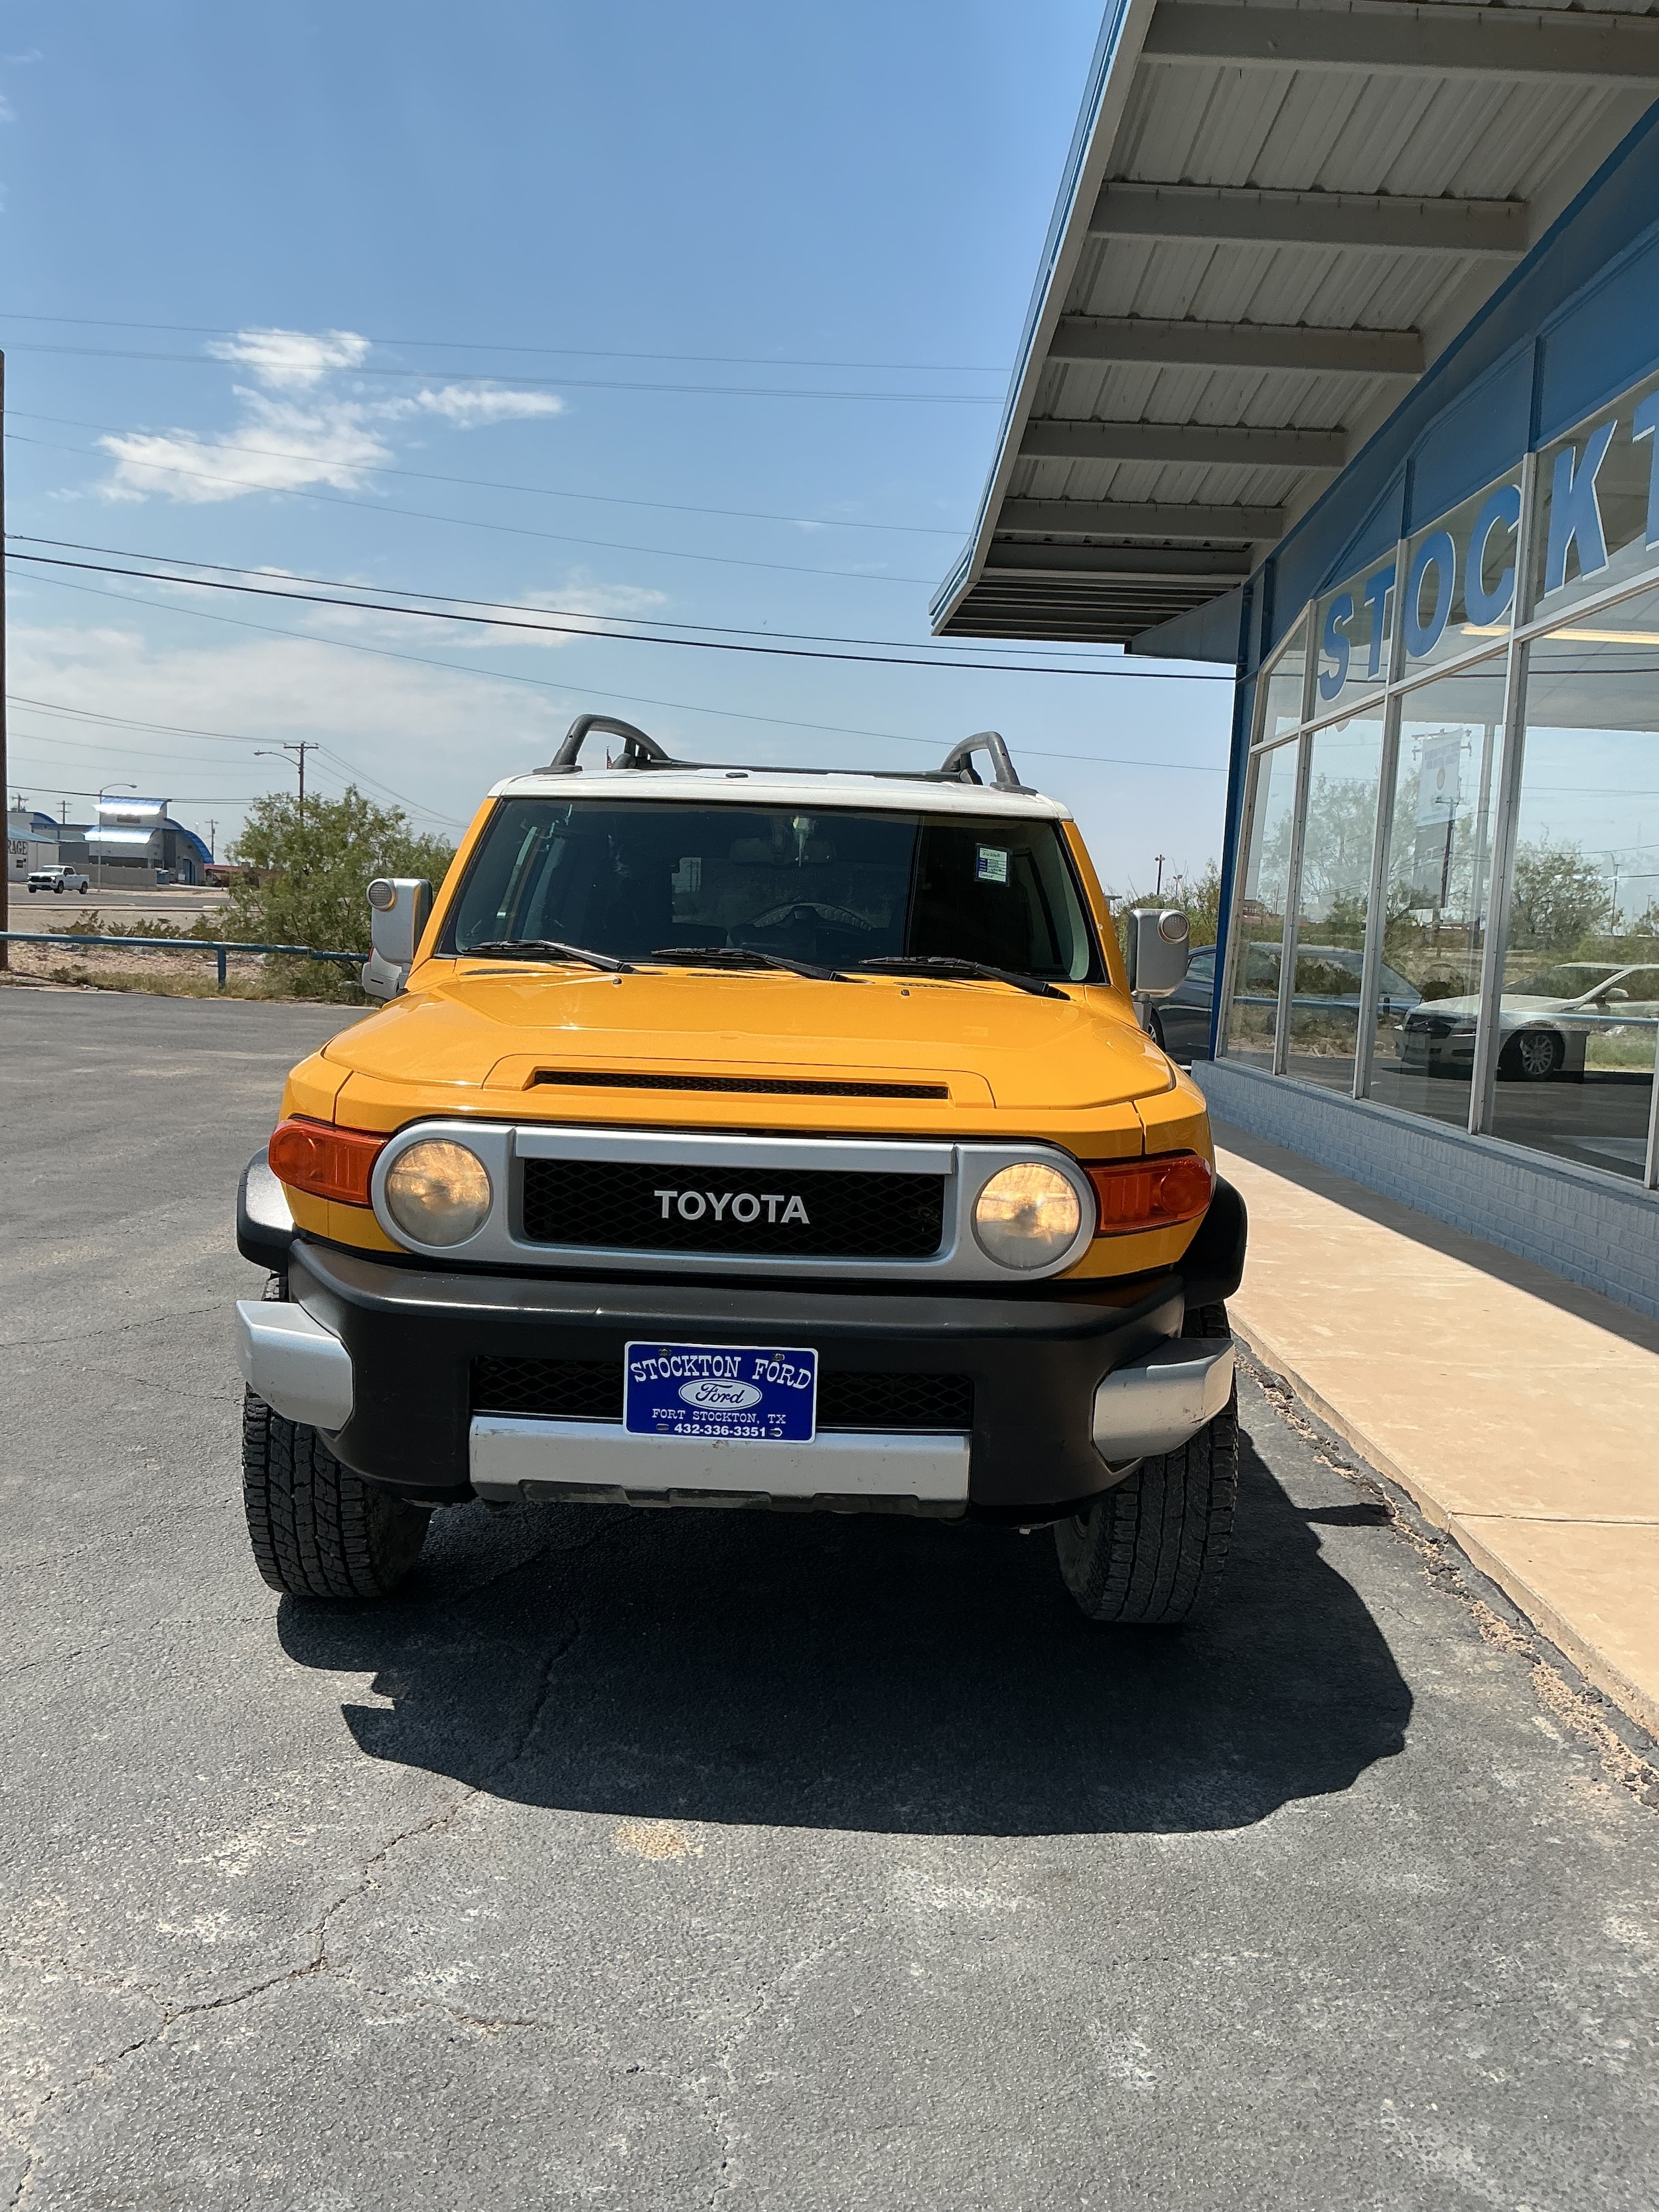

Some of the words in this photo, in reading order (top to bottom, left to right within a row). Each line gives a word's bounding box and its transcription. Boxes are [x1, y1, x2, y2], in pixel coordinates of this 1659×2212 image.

[654, 1189, 810, 1224] TOYOTA
[630, 1355, 742, 1383] STOCKTON
[752, 1358, 812, 1390] FORD
[695, 1382, 745, 1404] Ford
[652, 1408, 685, 1420] FORT
[692, 1411, 760, 1425] STOCKTON,
[767, 1414, 786, 1424] TX
[674, 1424, 766, 1438] 432-336-3351
